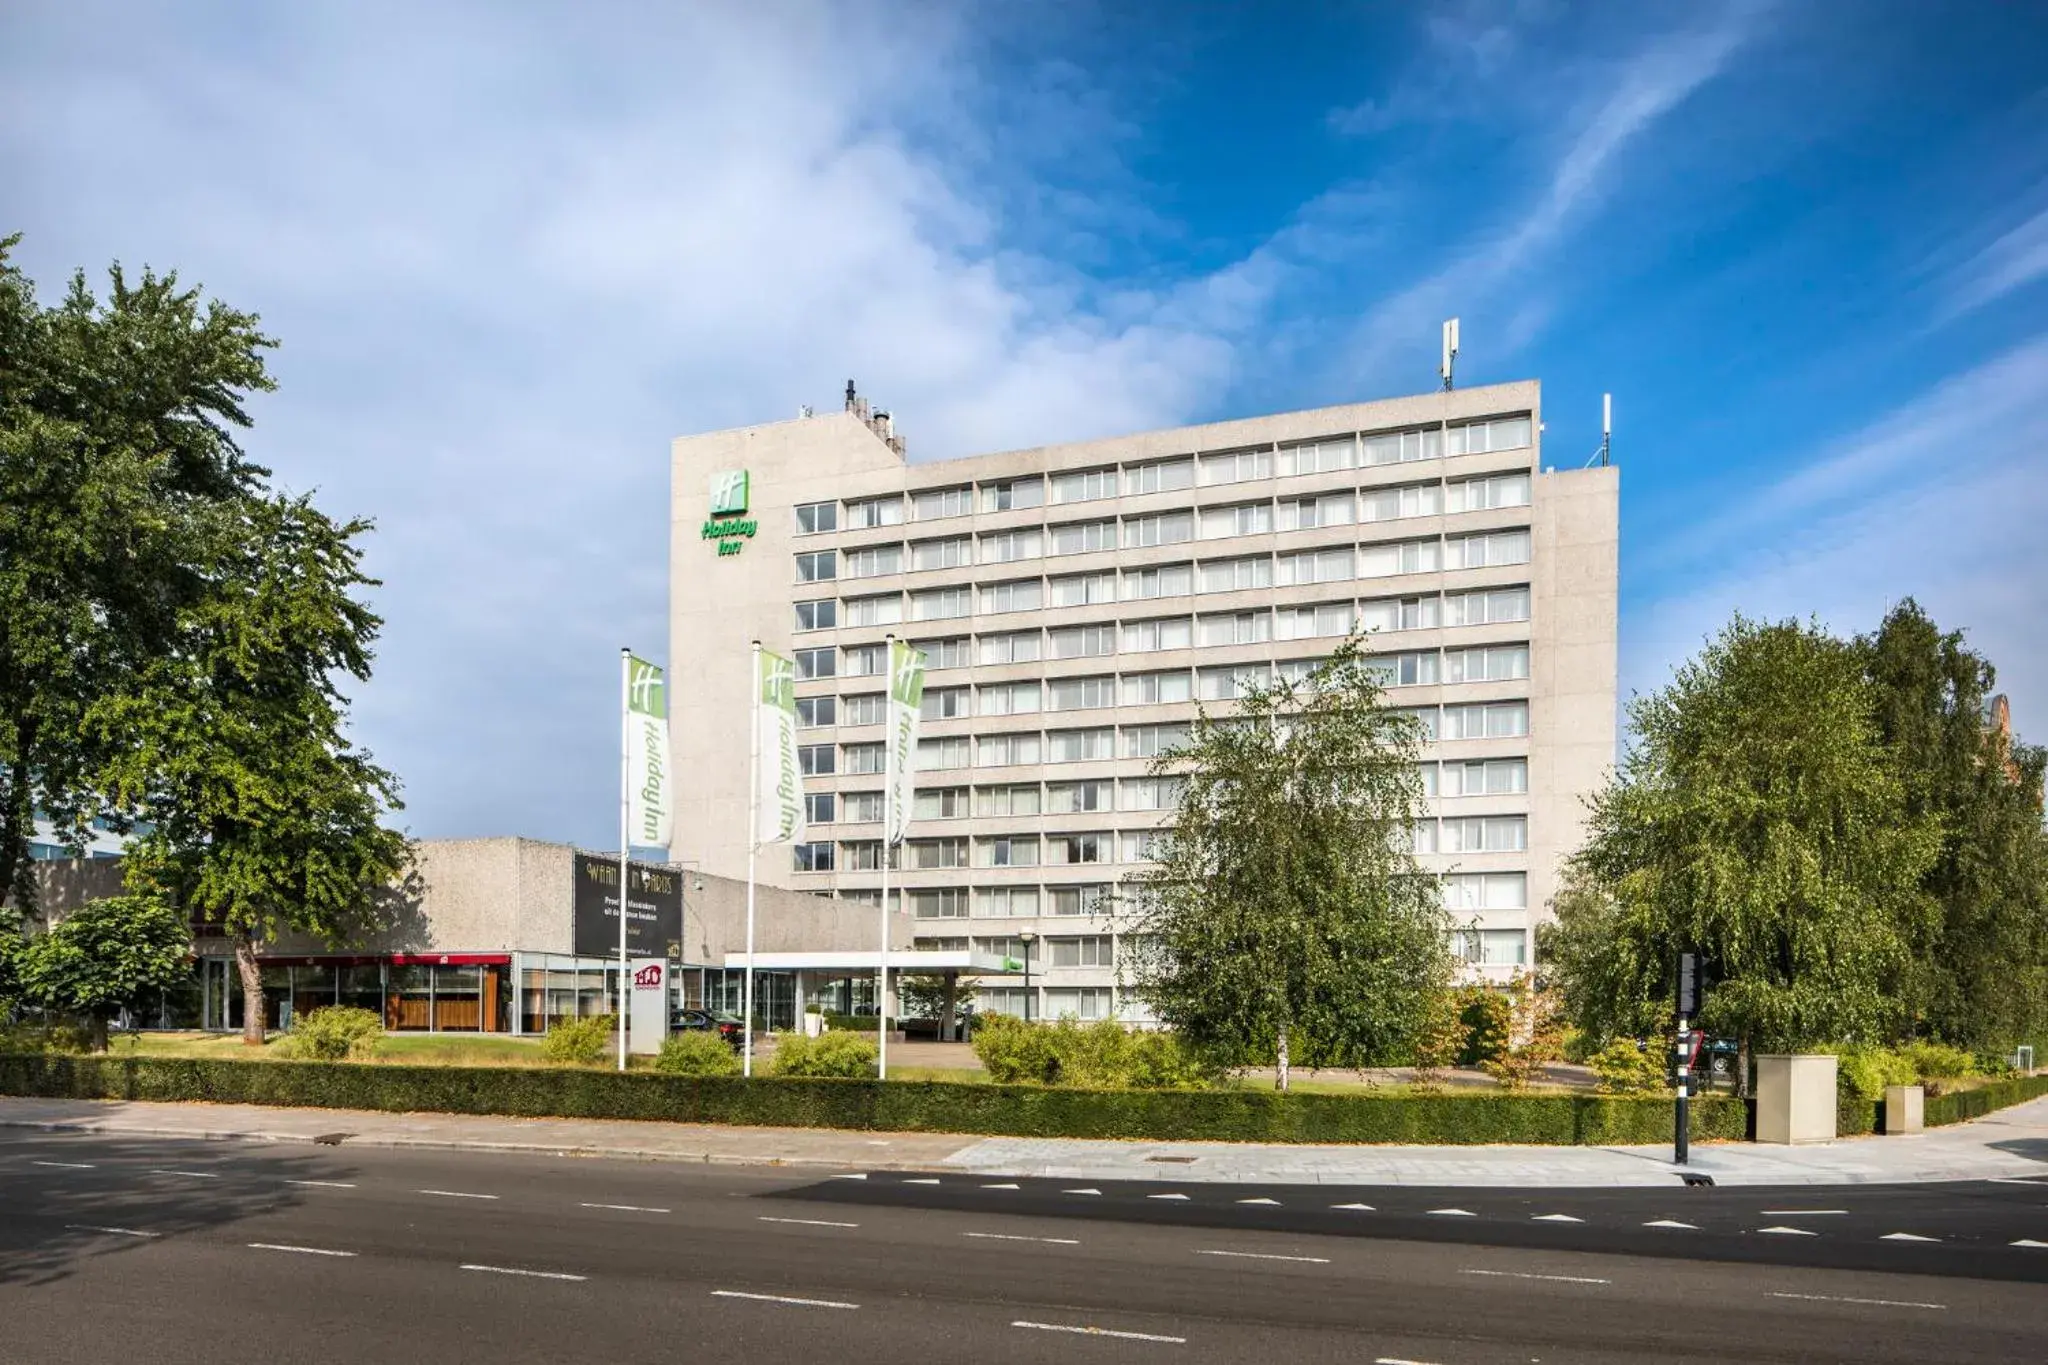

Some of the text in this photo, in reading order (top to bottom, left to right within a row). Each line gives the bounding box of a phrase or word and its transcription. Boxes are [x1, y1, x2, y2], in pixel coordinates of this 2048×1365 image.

[701, 518, 758, 540] Holiday
[641, 720, 666, 841] Holiday Inn
[776, 715, 796, 802] Holiday
